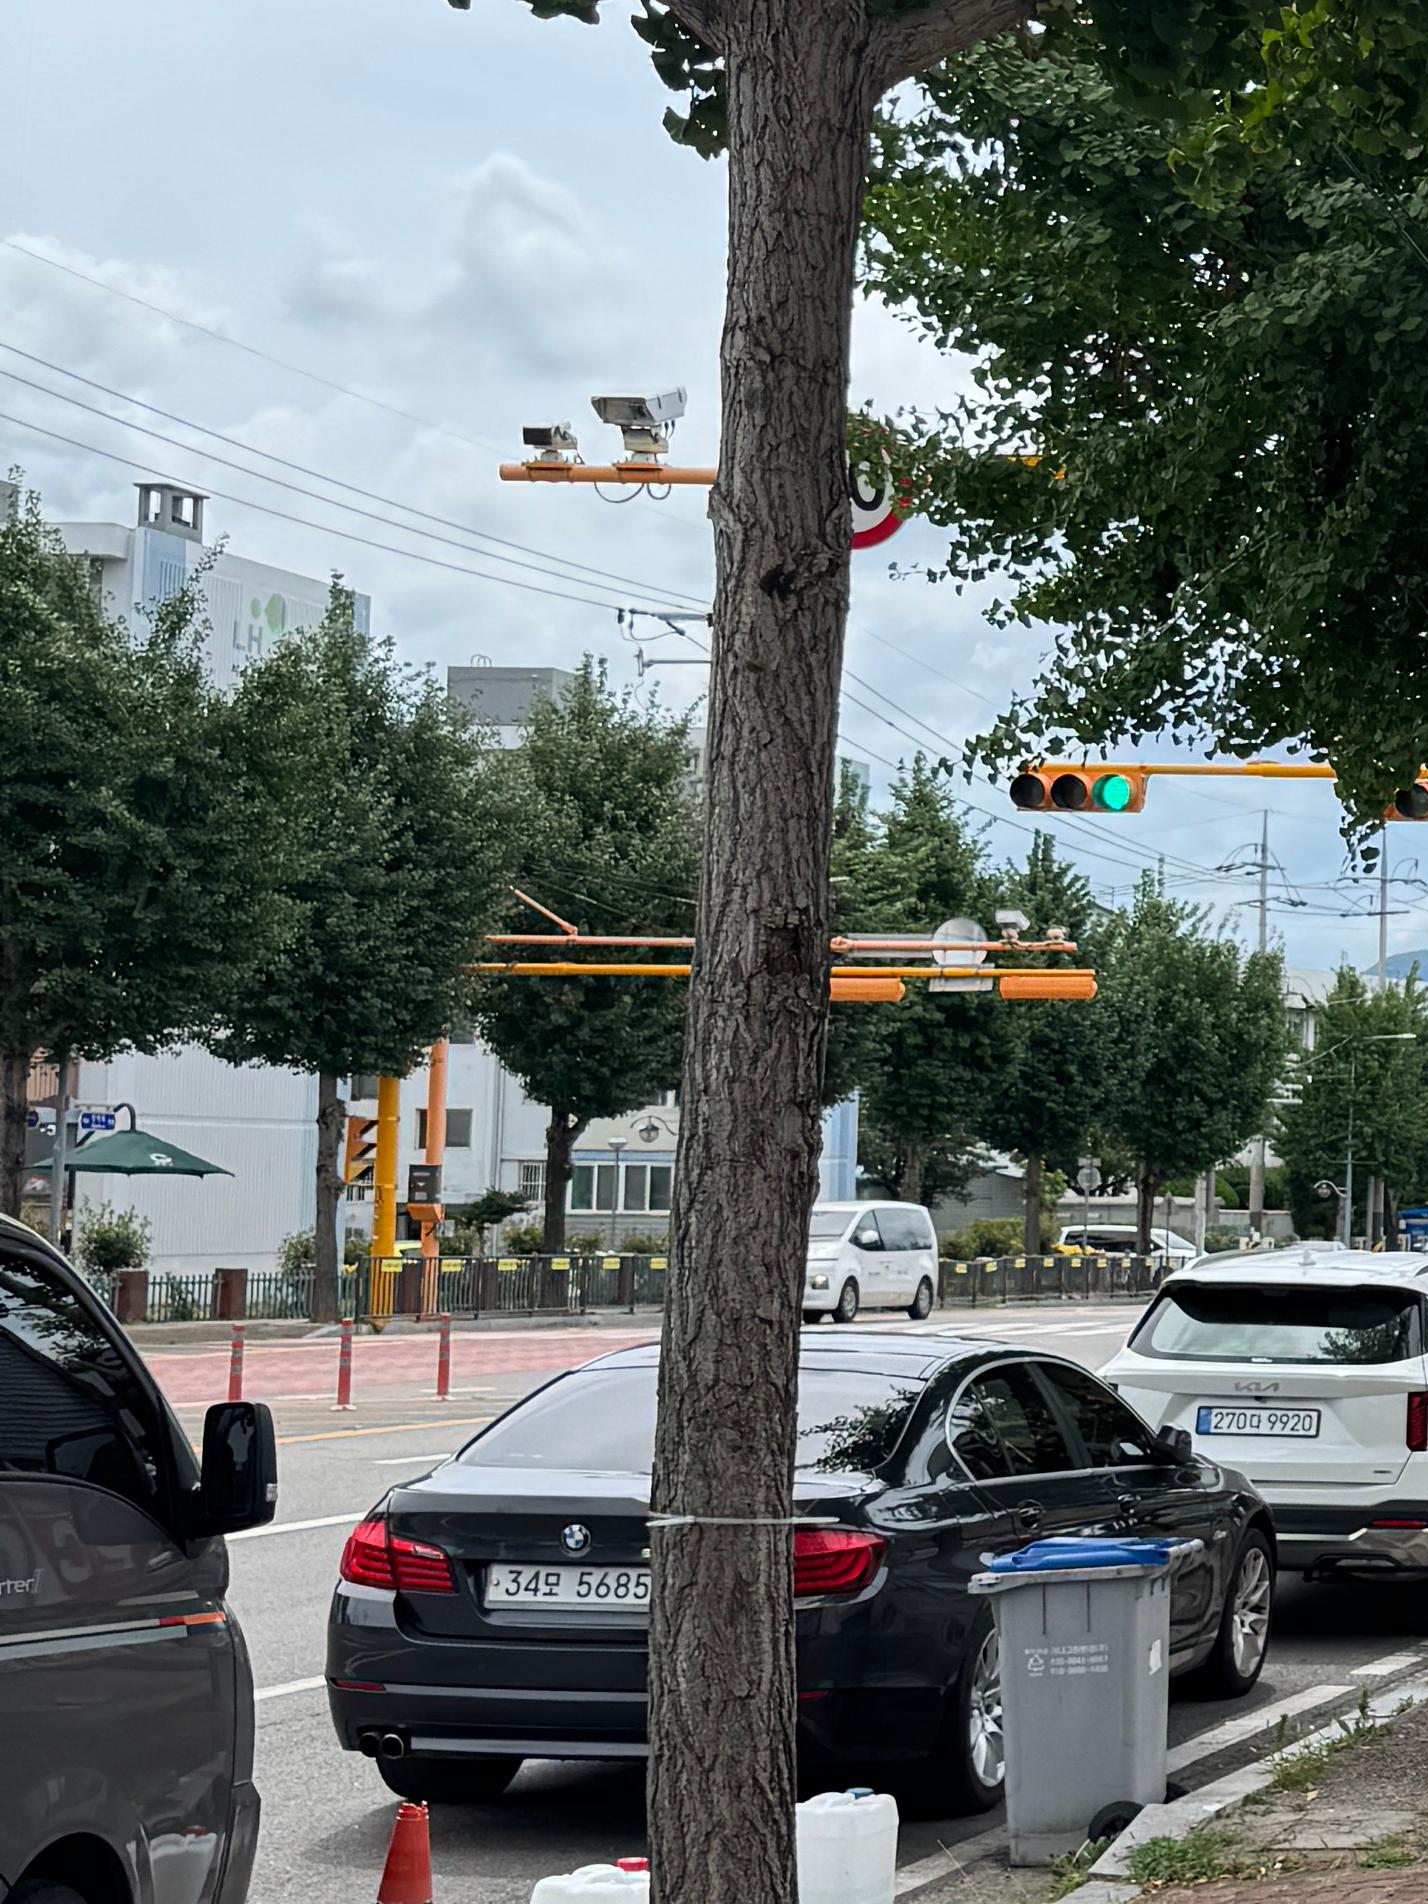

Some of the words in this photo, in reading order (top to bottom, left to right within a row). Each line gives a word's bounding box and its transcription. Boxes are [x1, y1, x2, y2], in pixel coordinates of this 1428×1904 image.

[1267, 1413, 1313, 1433] 9920
[505, 1569, 561, 1598] 34모
[576, 1571, 651, 1600] 5685
